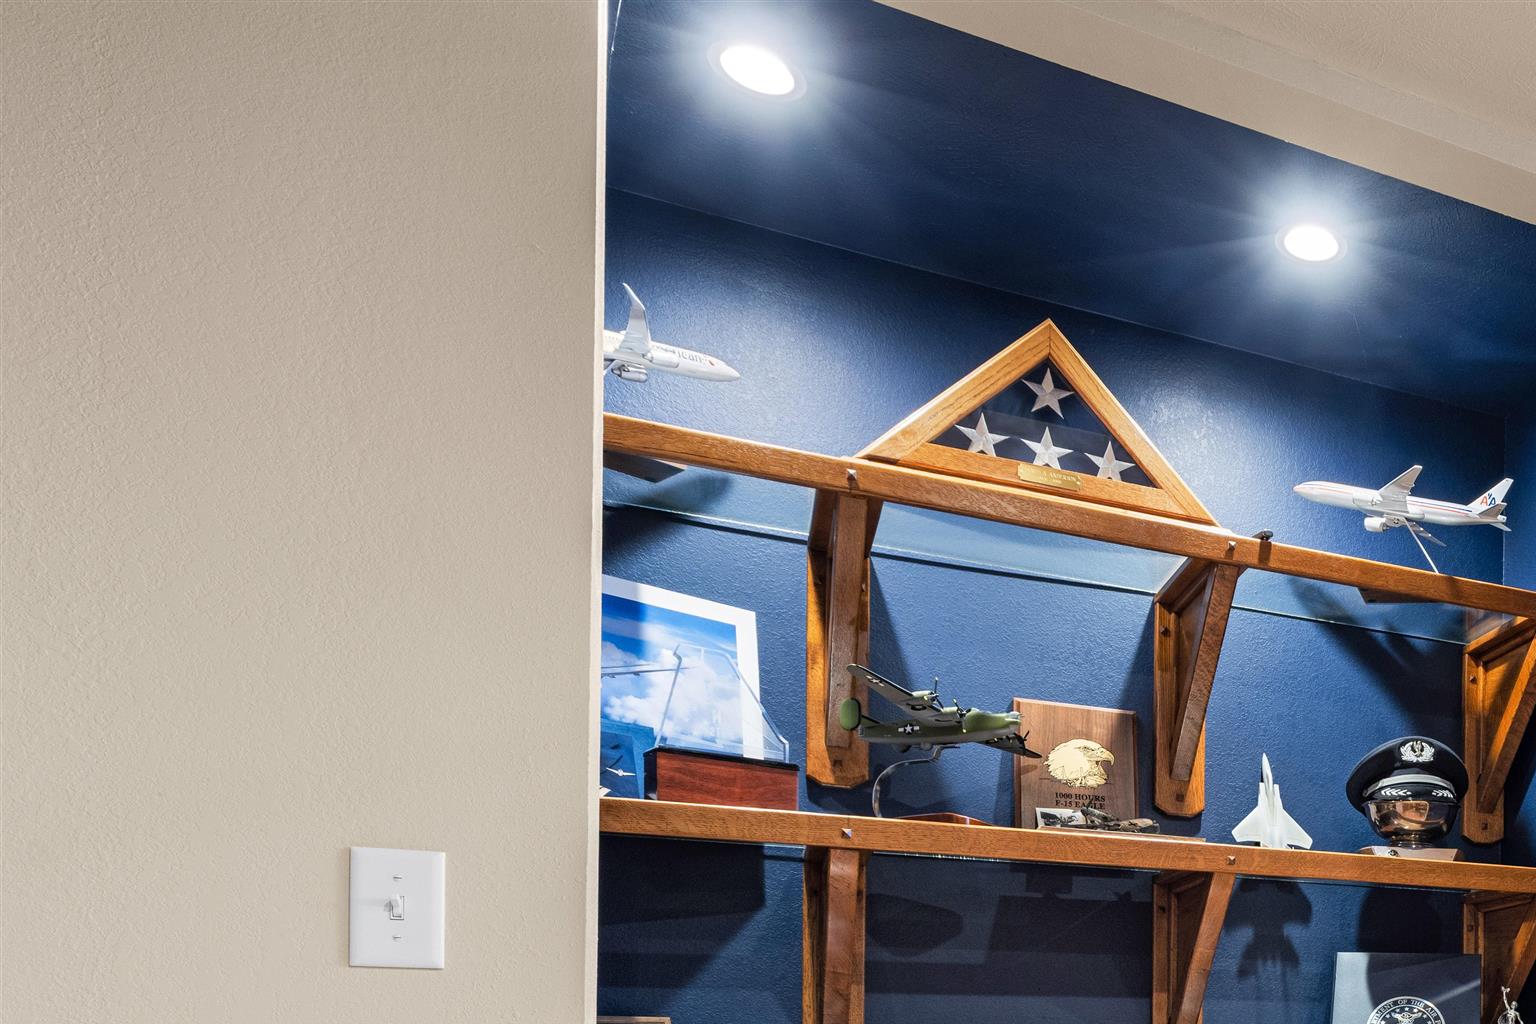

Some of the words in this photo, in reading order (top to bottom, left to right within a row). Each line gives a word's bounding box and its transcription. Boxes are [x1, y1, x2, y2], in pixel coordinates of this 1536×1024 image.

[1055, 792, 1073, 800] 1000
[1075, 793, 1106, 803] HOURS
[1055, 800, 1073, 808] F-15
